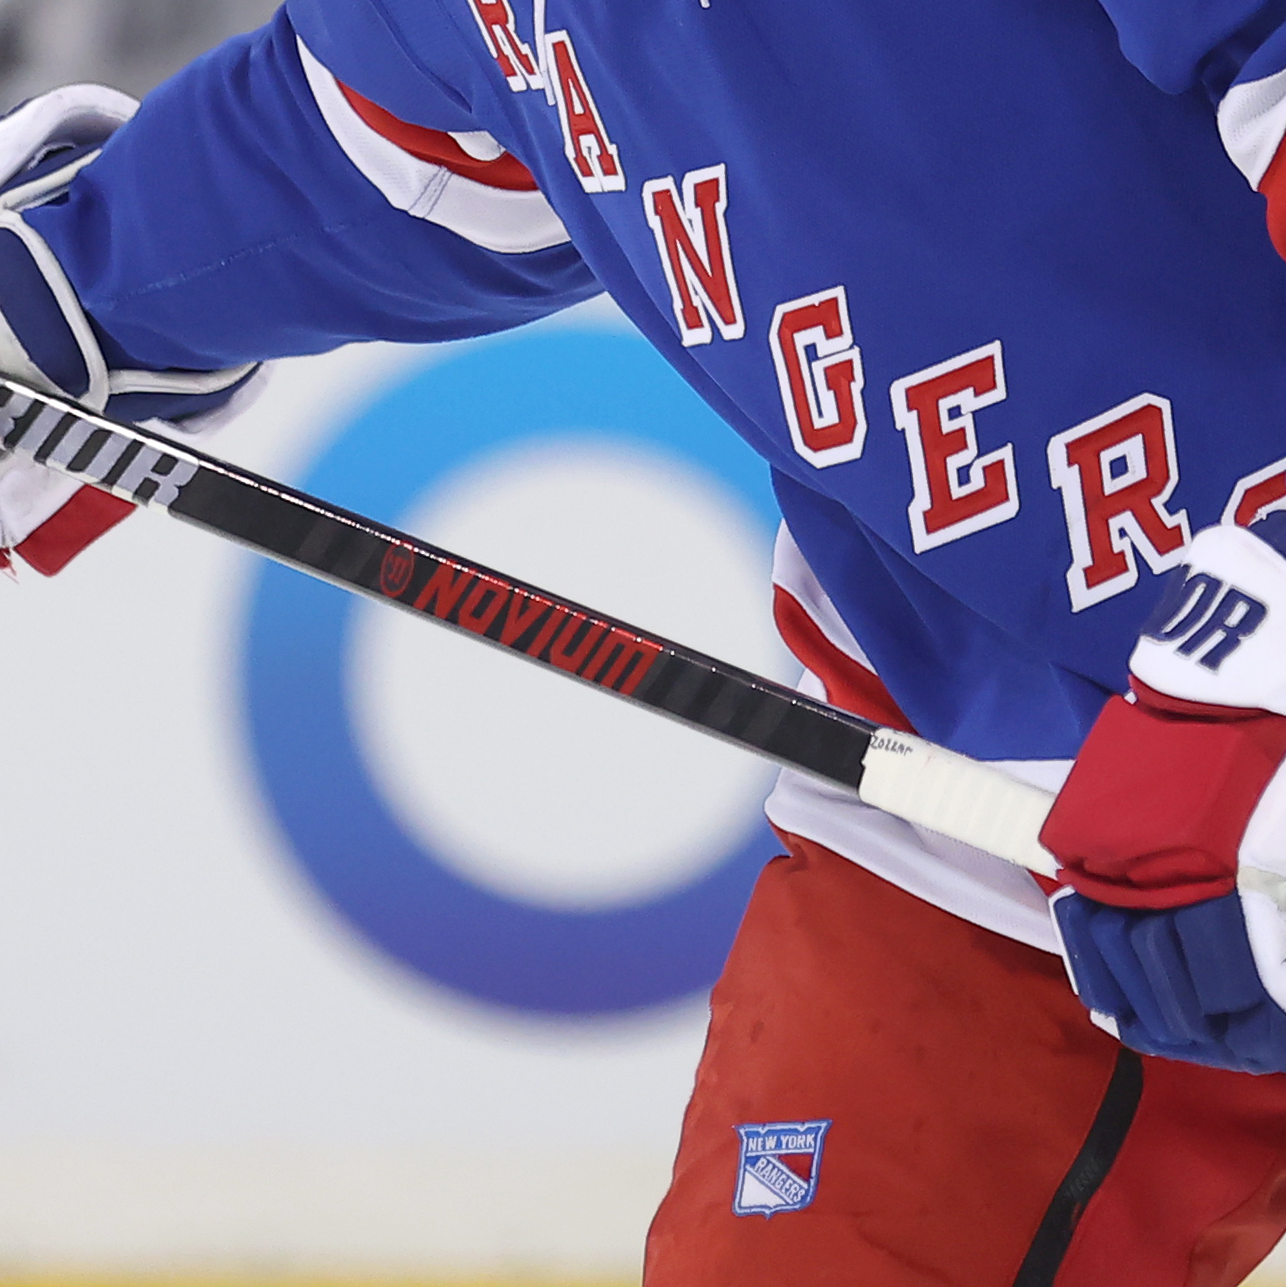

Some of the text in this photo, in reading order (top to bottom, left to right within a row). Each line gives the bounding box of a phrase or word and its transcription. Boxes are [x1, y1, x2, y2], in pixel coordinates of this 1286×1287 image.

[414, 560, 663, 697] NOVIUM
[748, 1133, 815, 1151] NEW YORK
[754, 1157, 806, 1204] RANGERS
